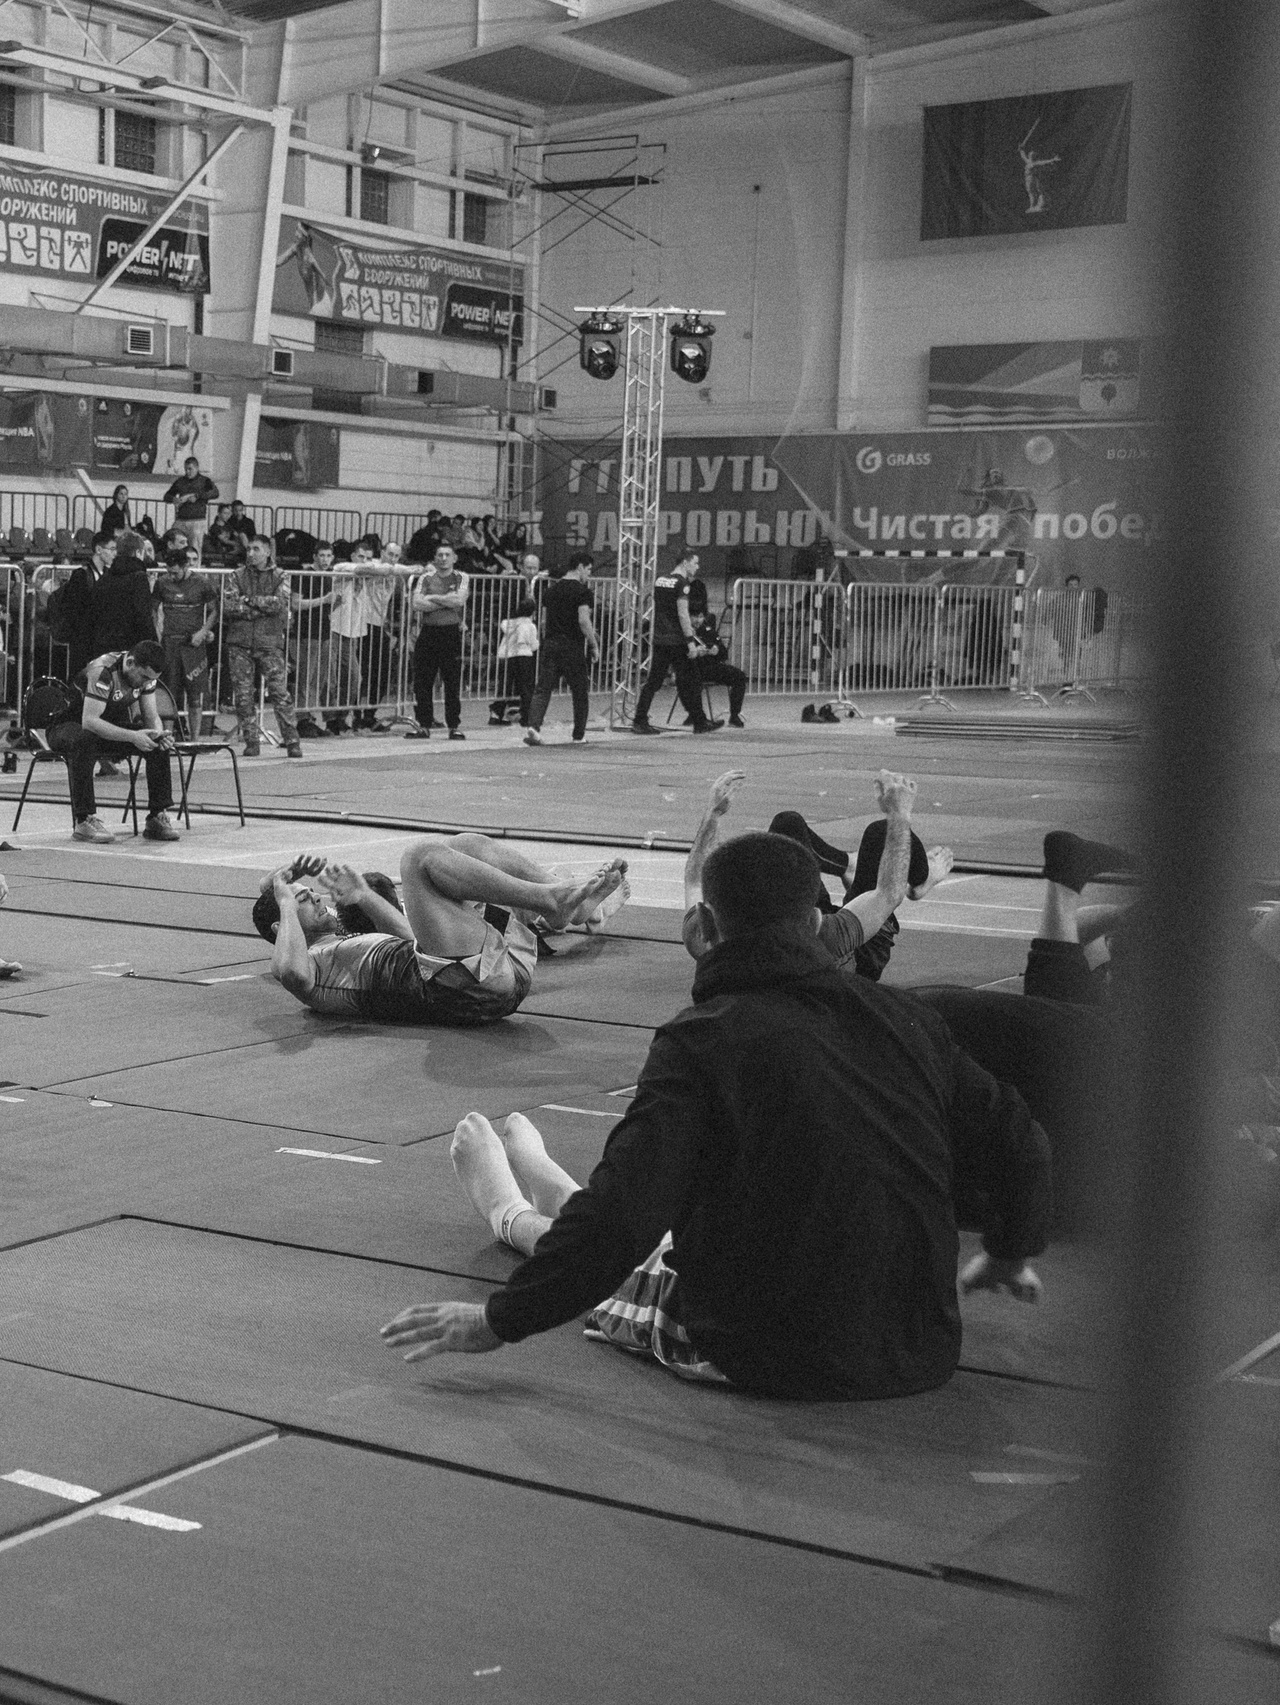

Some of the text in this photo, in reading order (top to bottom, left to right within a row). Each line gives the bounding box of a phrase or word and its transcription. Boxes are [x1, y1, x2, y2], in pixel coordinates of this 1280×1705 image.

[60, 184, 149, 216] СПОРТИВНЫХ
[451, 302, 490, 323] POWER
[666, 455, 779, 492] ПУТЬ
[886, 452, 931, 467] GRASS
[852, 501, 1145, 540] Чистая побе
